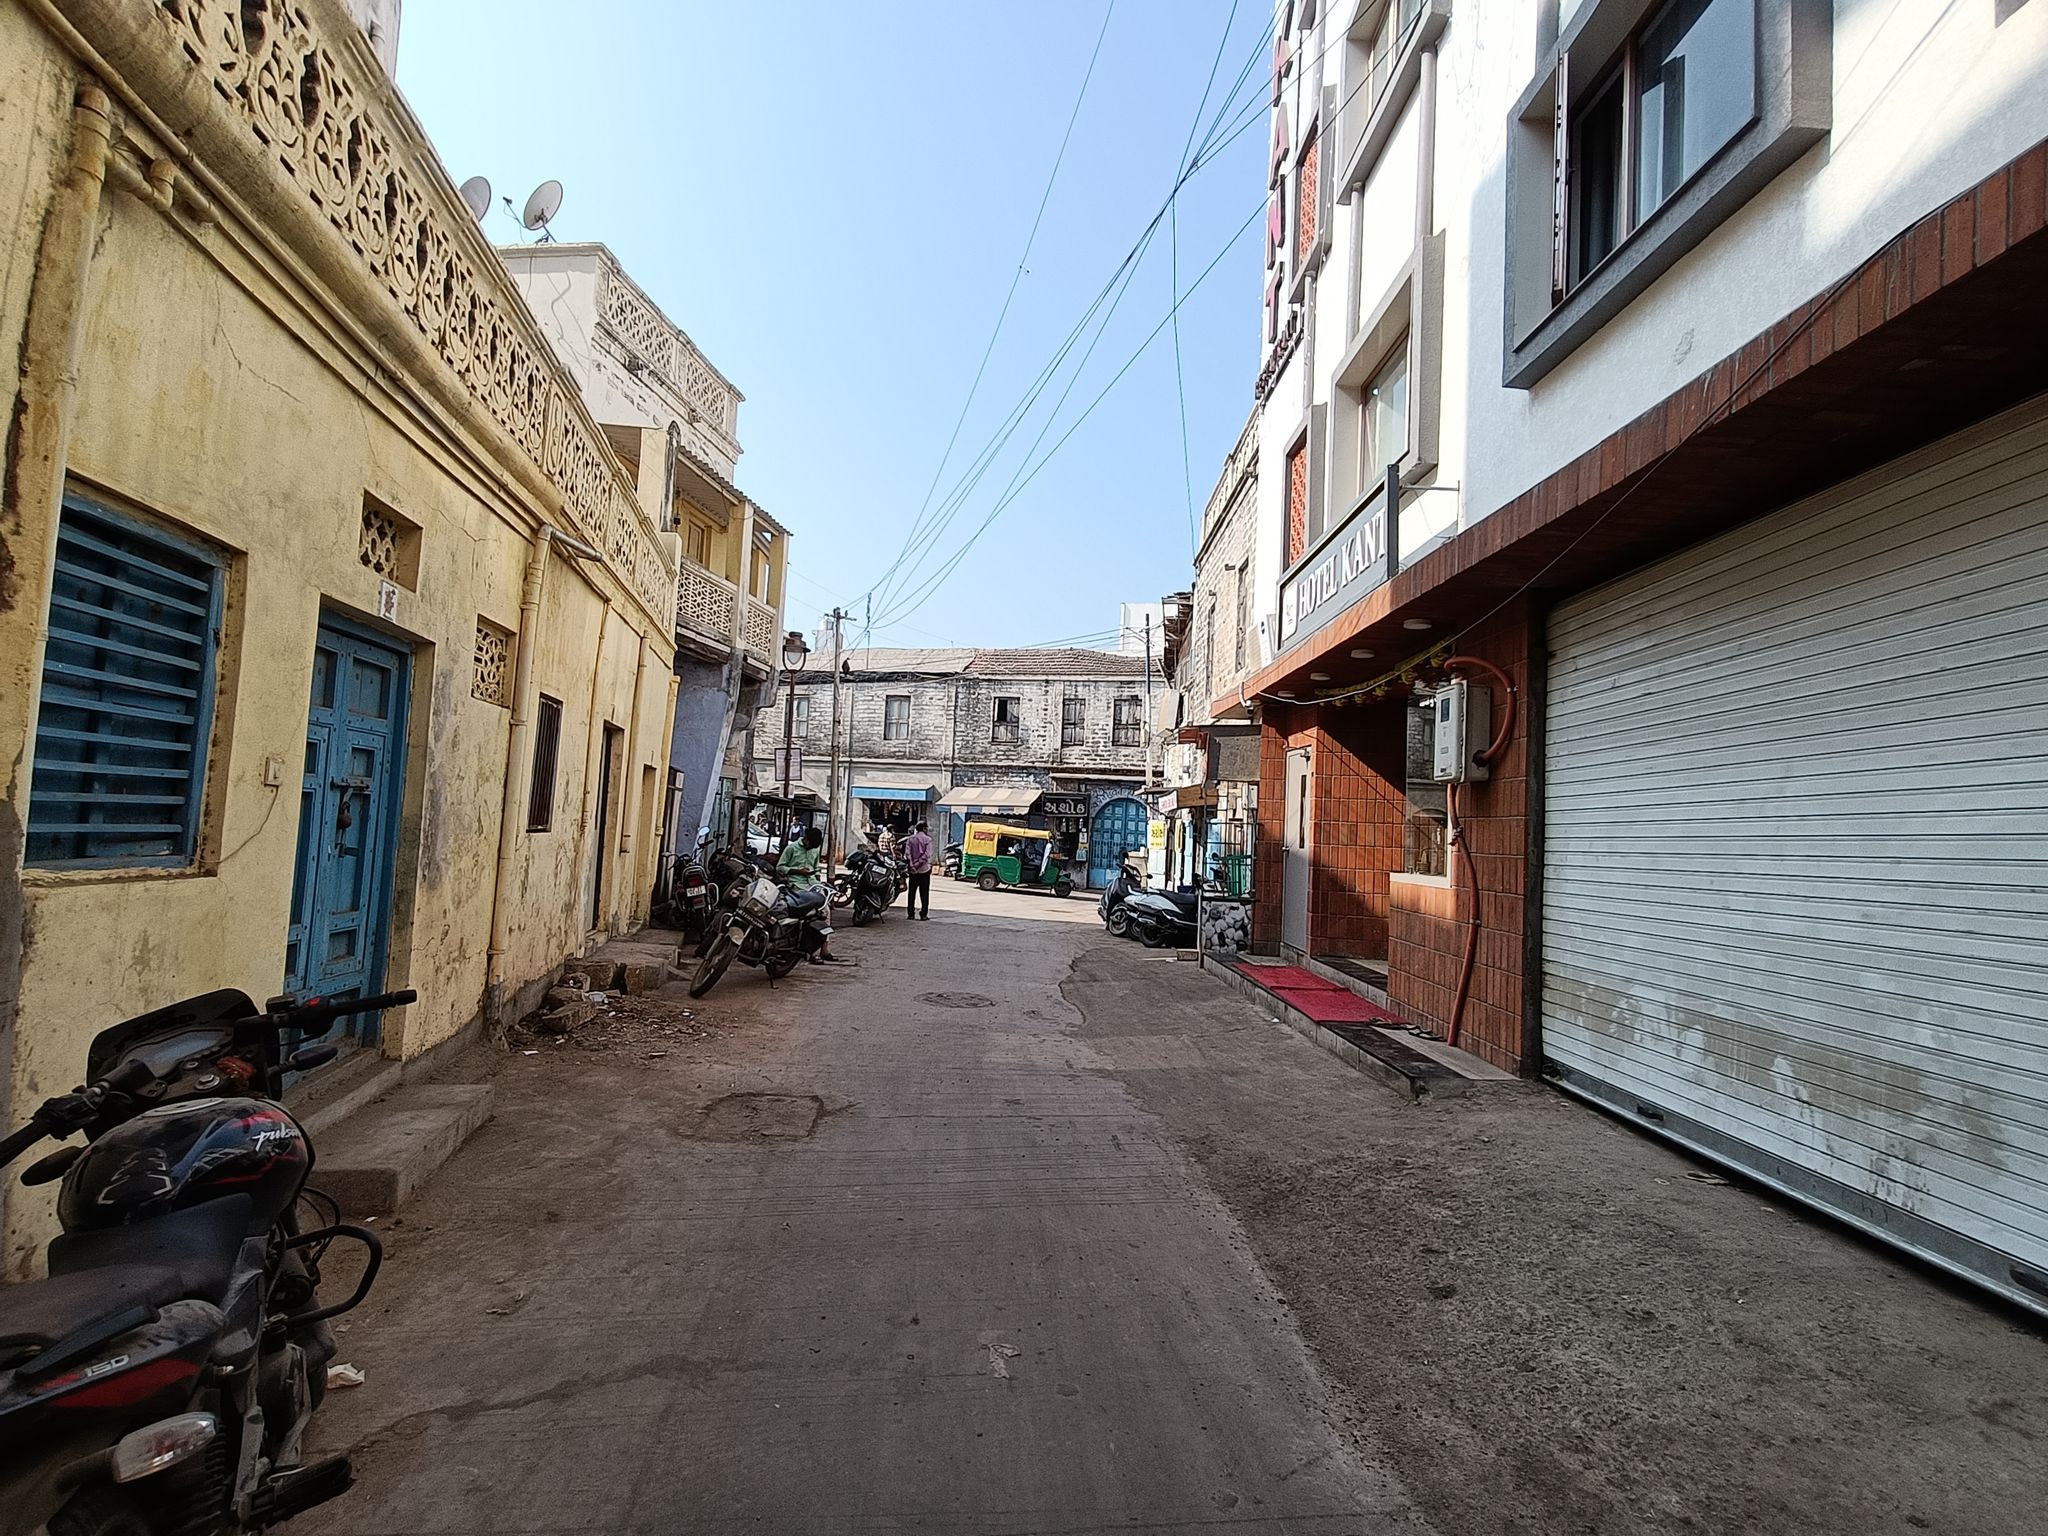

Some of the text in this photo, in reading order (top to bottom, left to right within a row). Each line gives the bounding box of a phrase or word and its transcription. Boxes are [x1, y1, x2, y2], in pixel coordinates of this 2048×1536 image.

[1299, 506, 1386, 621] HOTEL KANT
[84, 1354, 129, 1377] 150
